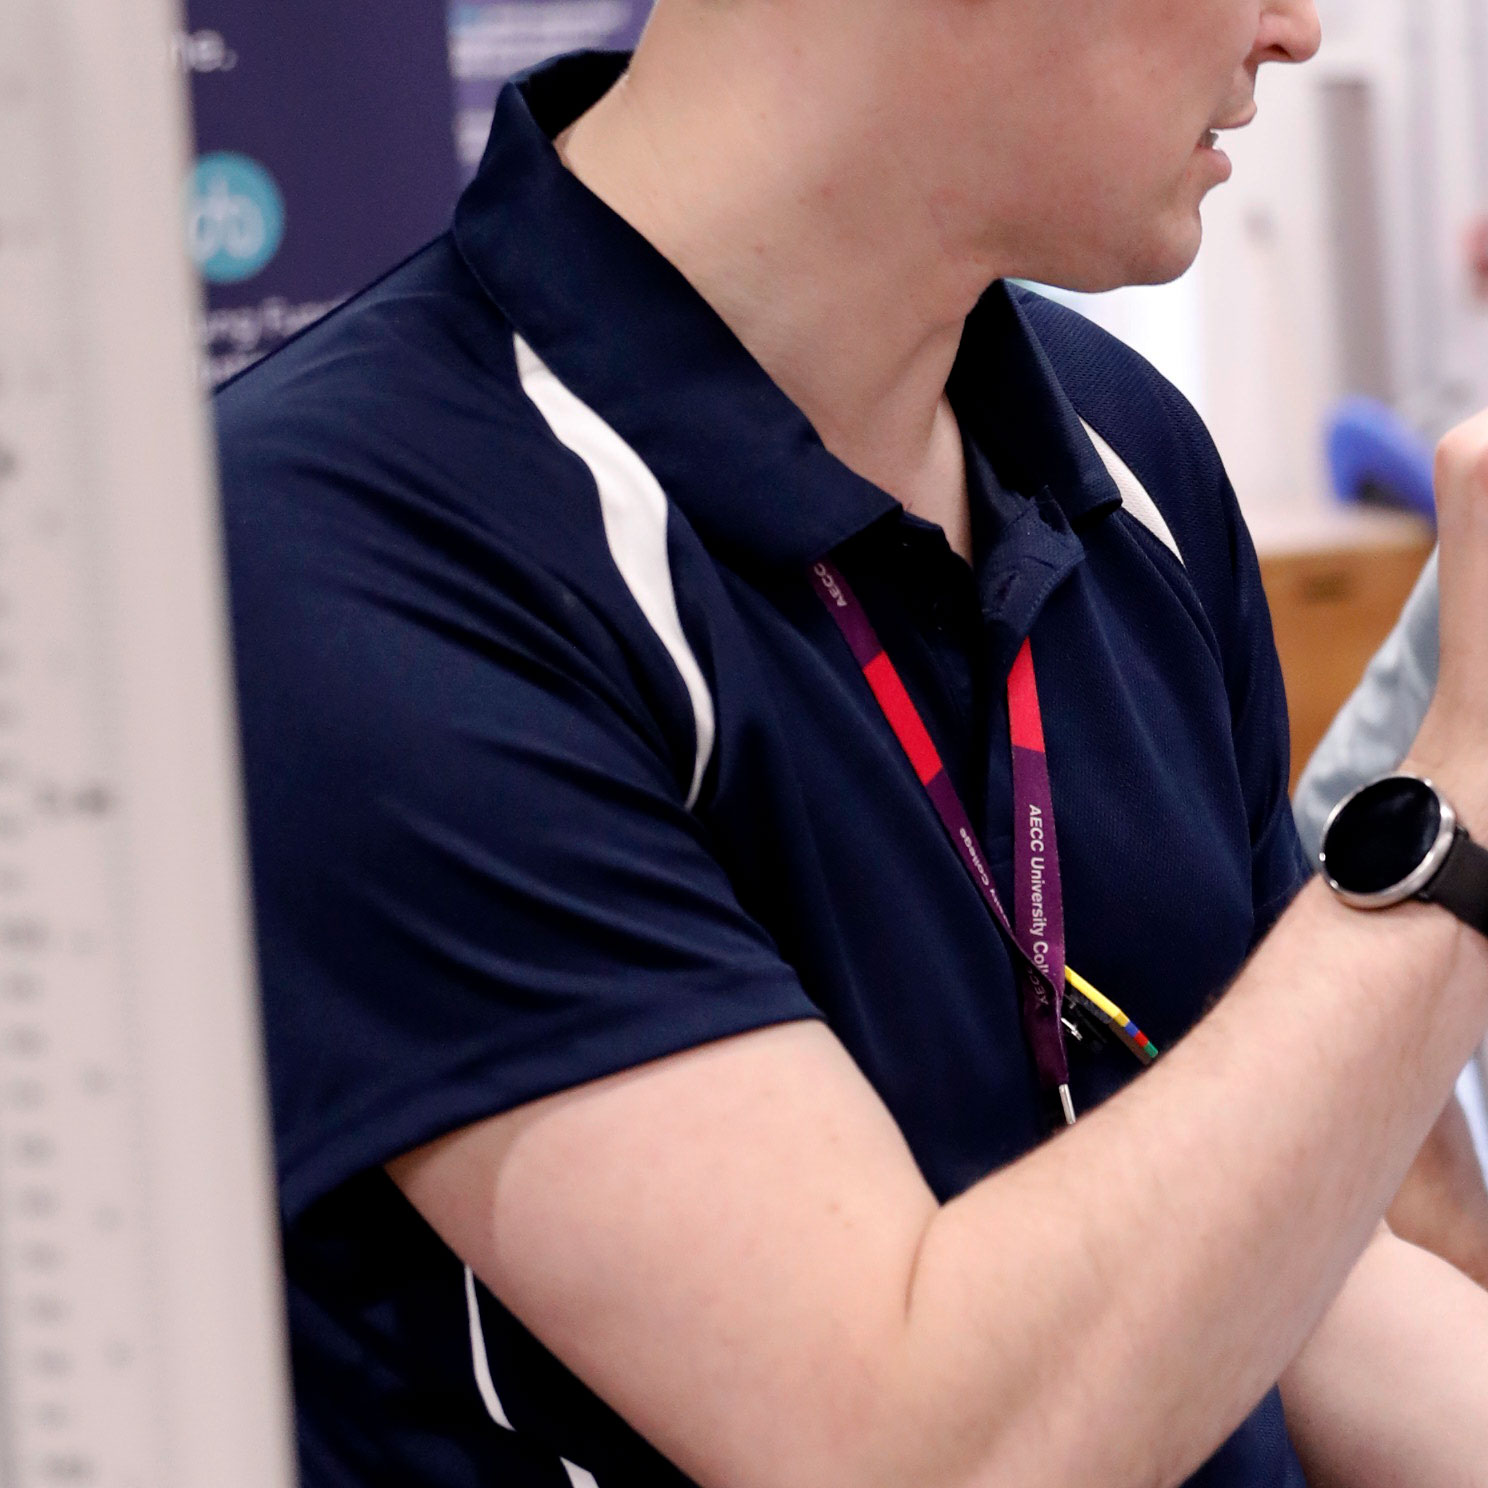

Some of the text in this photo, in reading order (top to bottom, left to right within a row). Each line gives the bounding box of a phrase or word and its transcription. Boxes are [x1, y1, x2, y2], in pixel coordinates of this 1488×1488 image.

[813, 563, 848, 607] AECC
[1028, 804, 1045, 852] AECC
[959, 827, 990, 886] College
[1029, 856, 1048, 936] University
